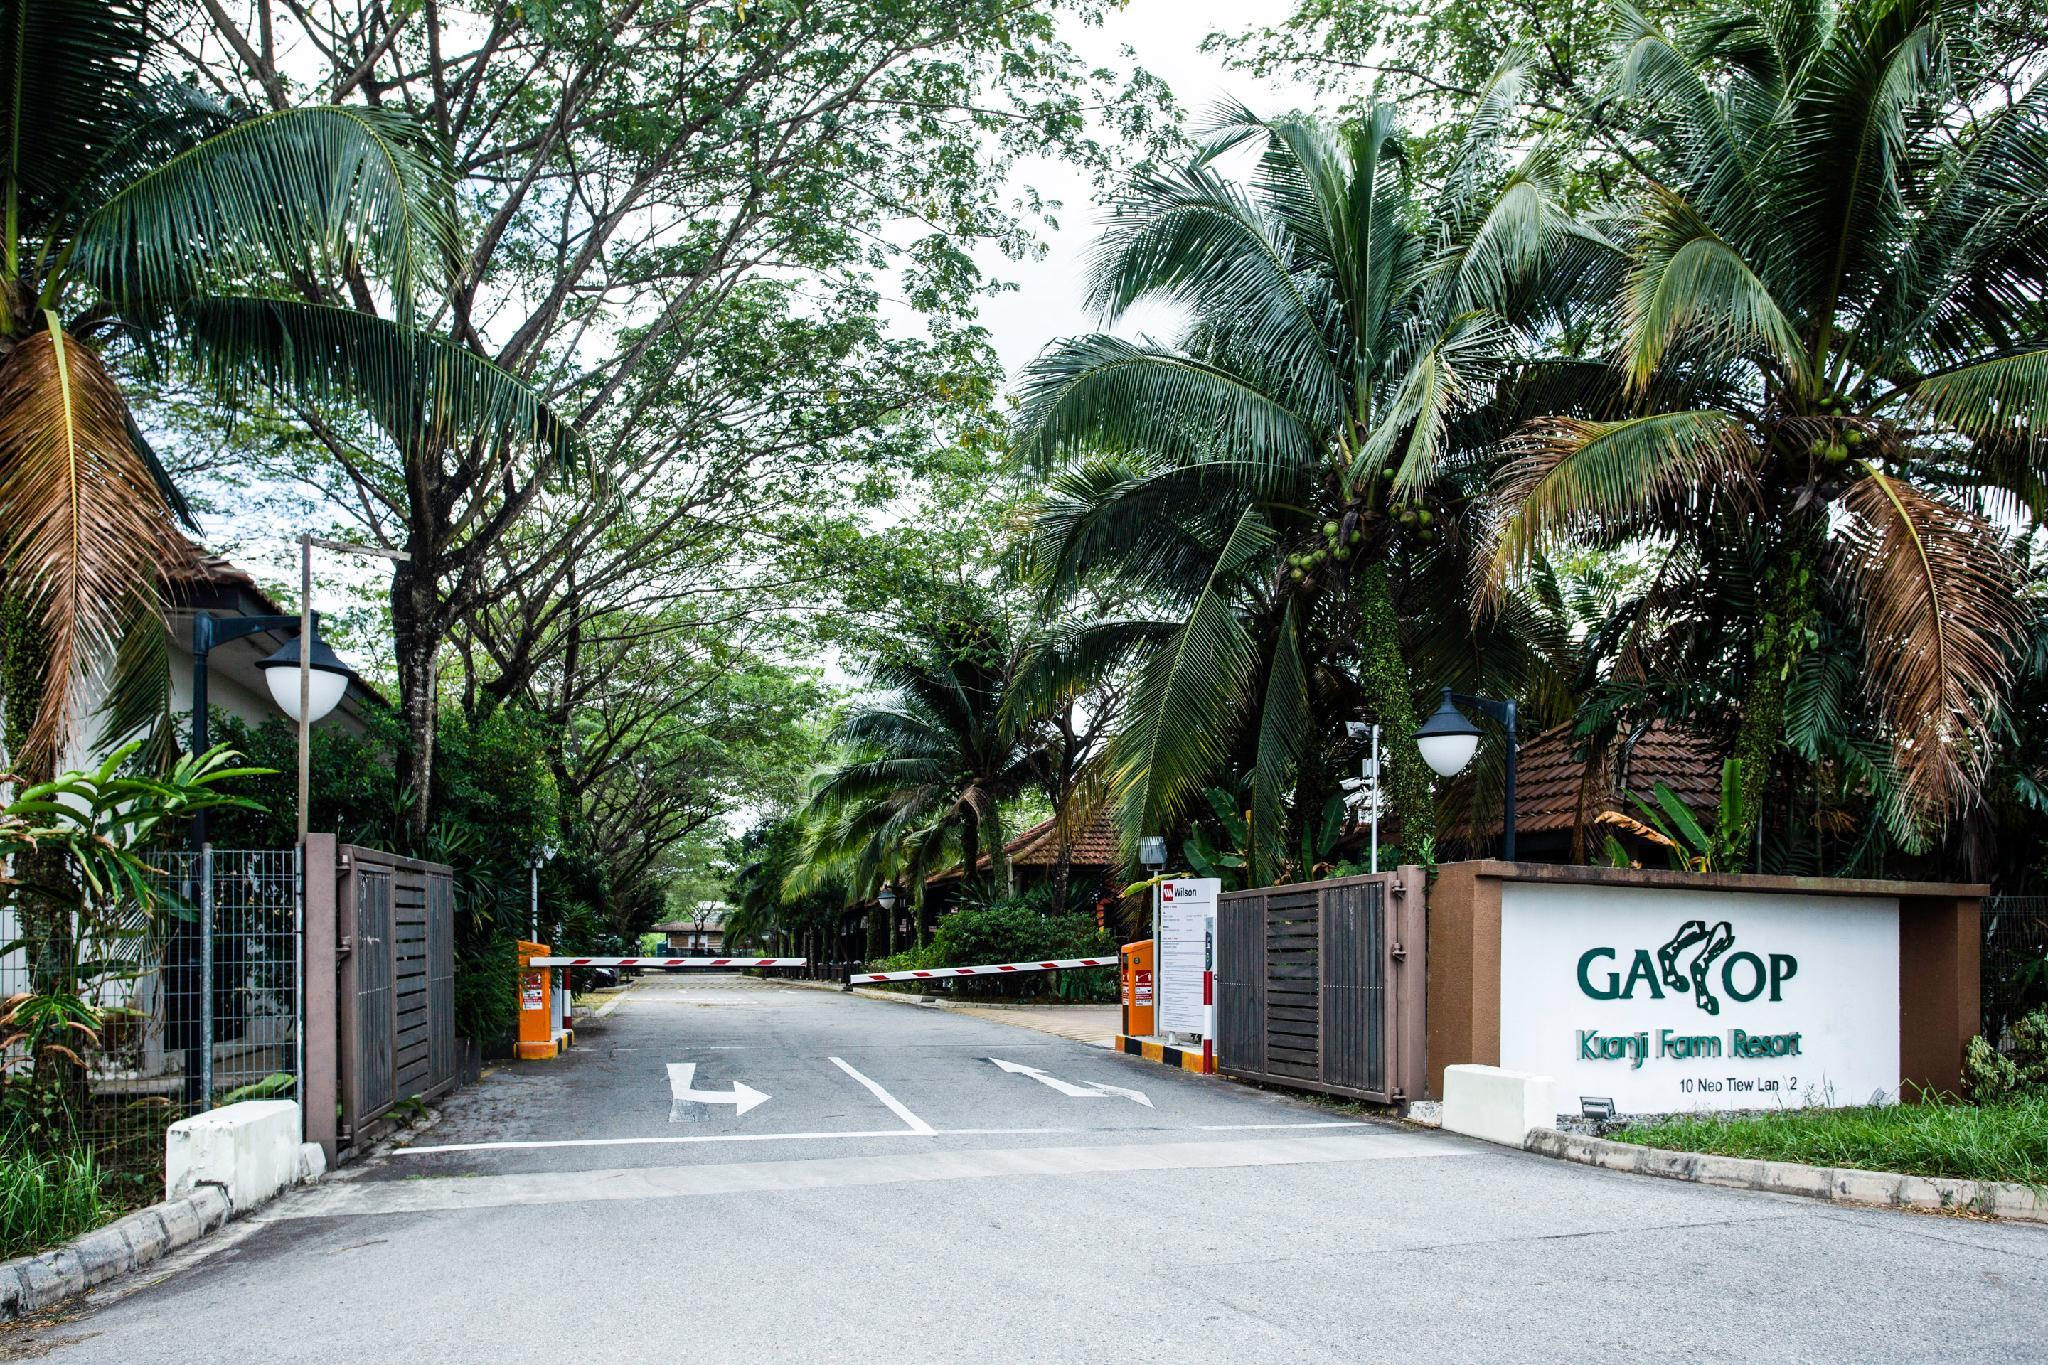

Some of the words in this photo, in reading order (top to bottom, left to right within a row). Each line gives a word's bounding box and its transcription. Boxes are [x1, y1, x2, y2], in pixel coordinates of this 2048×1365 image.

[1174, 887, 1197, 897] Wilson
[1577, 1029, 1649, 1070] Kranji
[1656, 1029, 1722, 1059] Farm
[1728, 1029, 1803, 1058] Resort
[1680, 1078, 1694, 1093] 10
[1698, 1077, 1723, 1092] Neo
[1726, 1077, 1754, 1092] Tiew
[1790, 1076, 1797, 1090] 2
